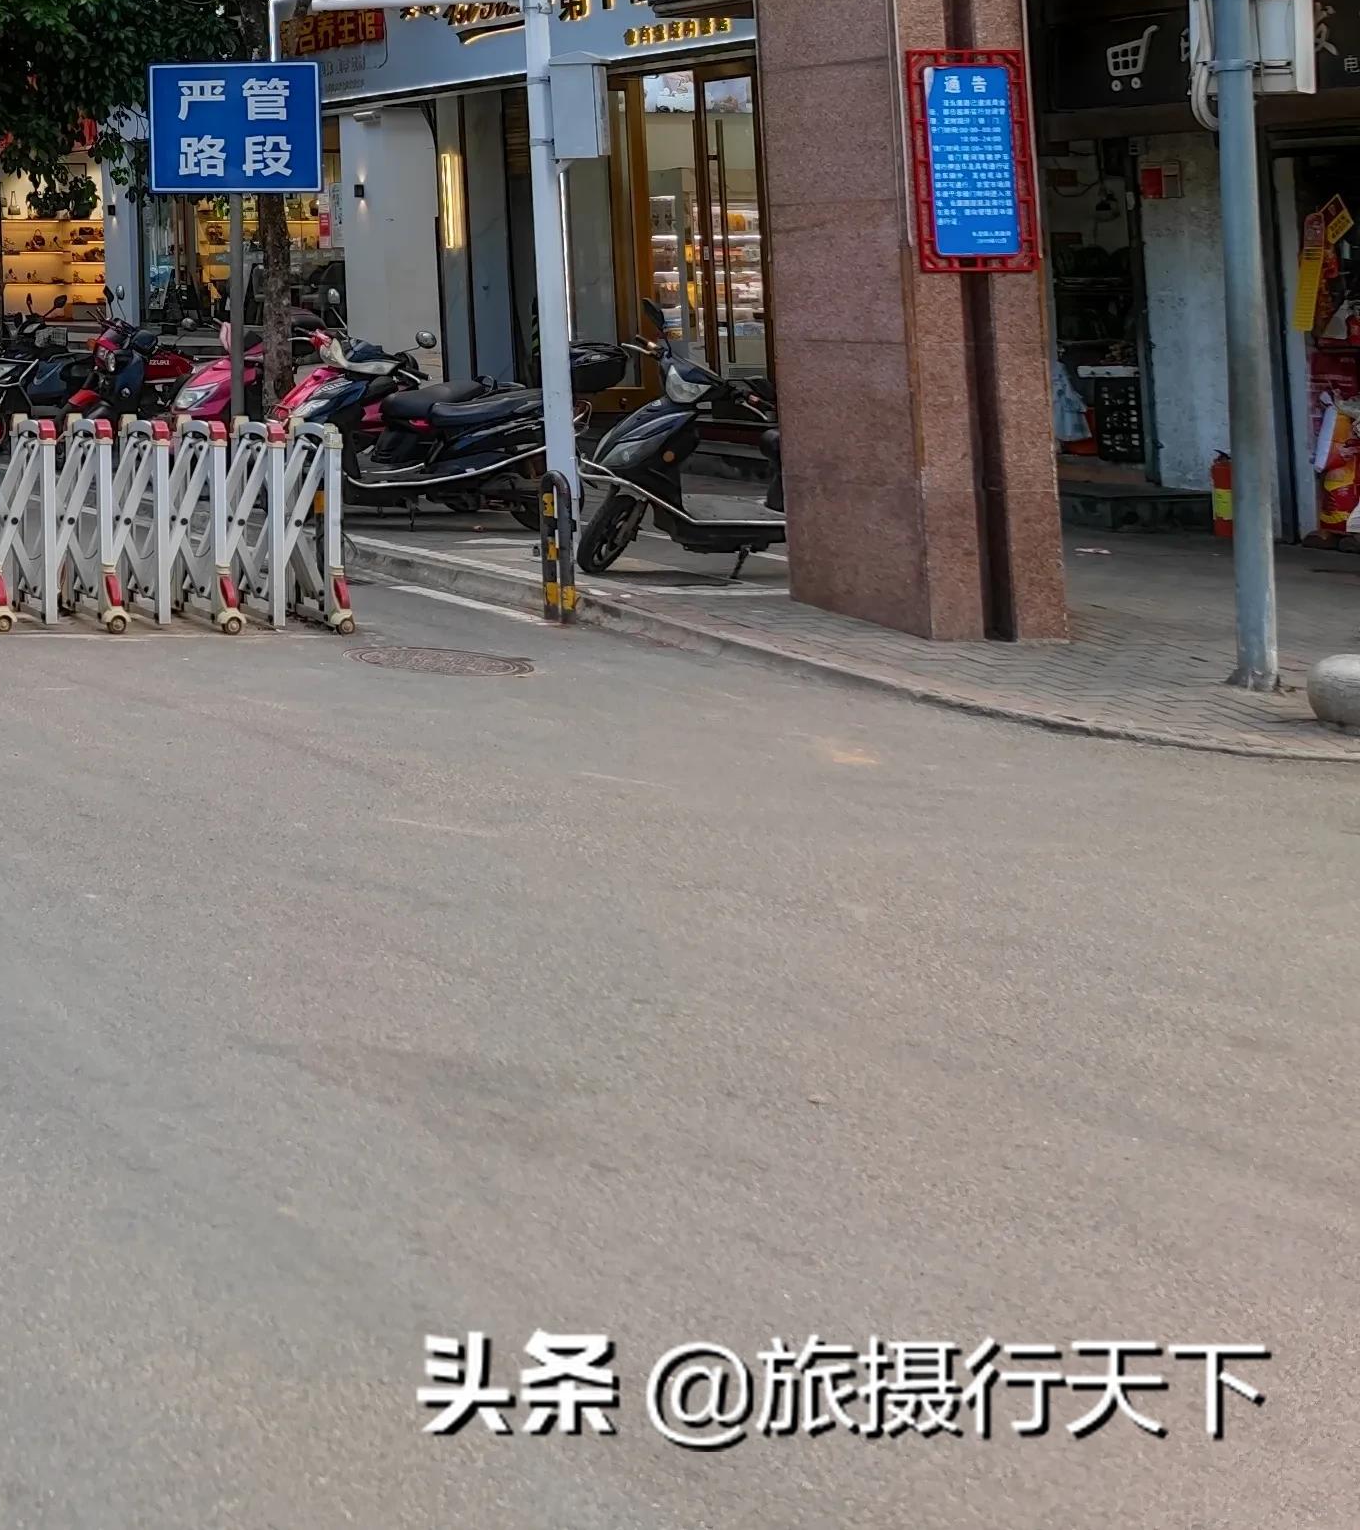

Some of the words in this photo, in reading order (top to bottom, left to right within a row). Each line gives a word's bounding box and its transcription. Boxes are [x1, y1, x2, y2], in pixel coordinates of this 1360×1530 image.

[178, 77, 290, 121] 严管
[944, 75, 988, 94] 通告
[178, 134, 292, 178] 路段
